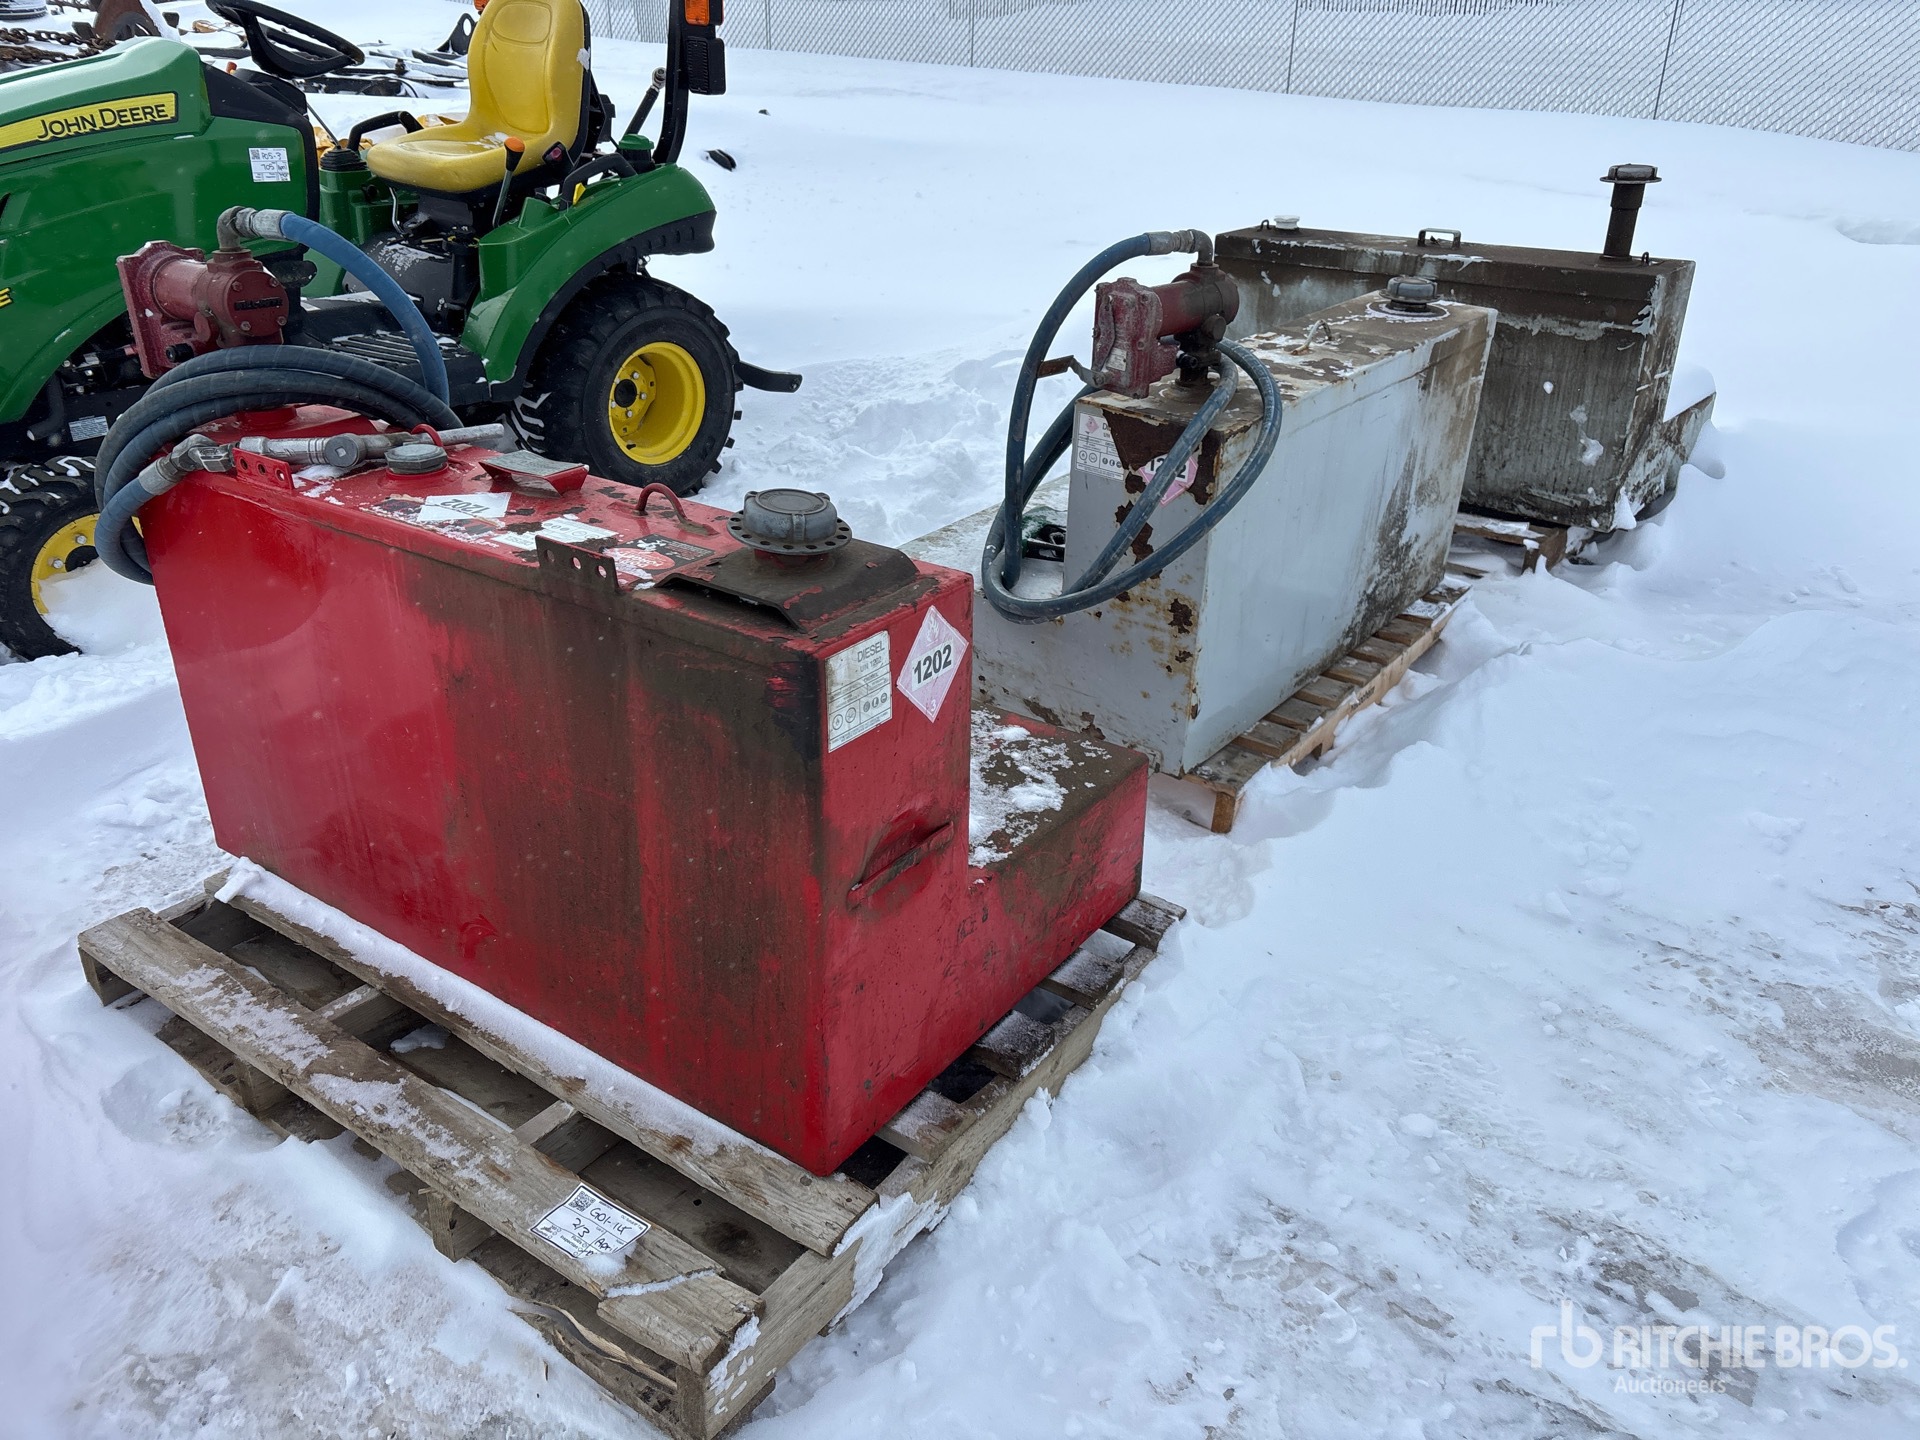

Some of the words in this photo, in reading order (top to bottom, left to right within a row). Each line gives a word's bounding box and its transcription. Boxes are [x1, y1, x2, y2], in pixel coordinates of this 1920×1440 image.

[37, 113, 97, 140] JOHN
[98, 103, 169, 127] DEERE
[441, 498, 490, 514] 1202
[857, 641, 885, 663] DIESEL
[914, 644, 952, 684] 1202
